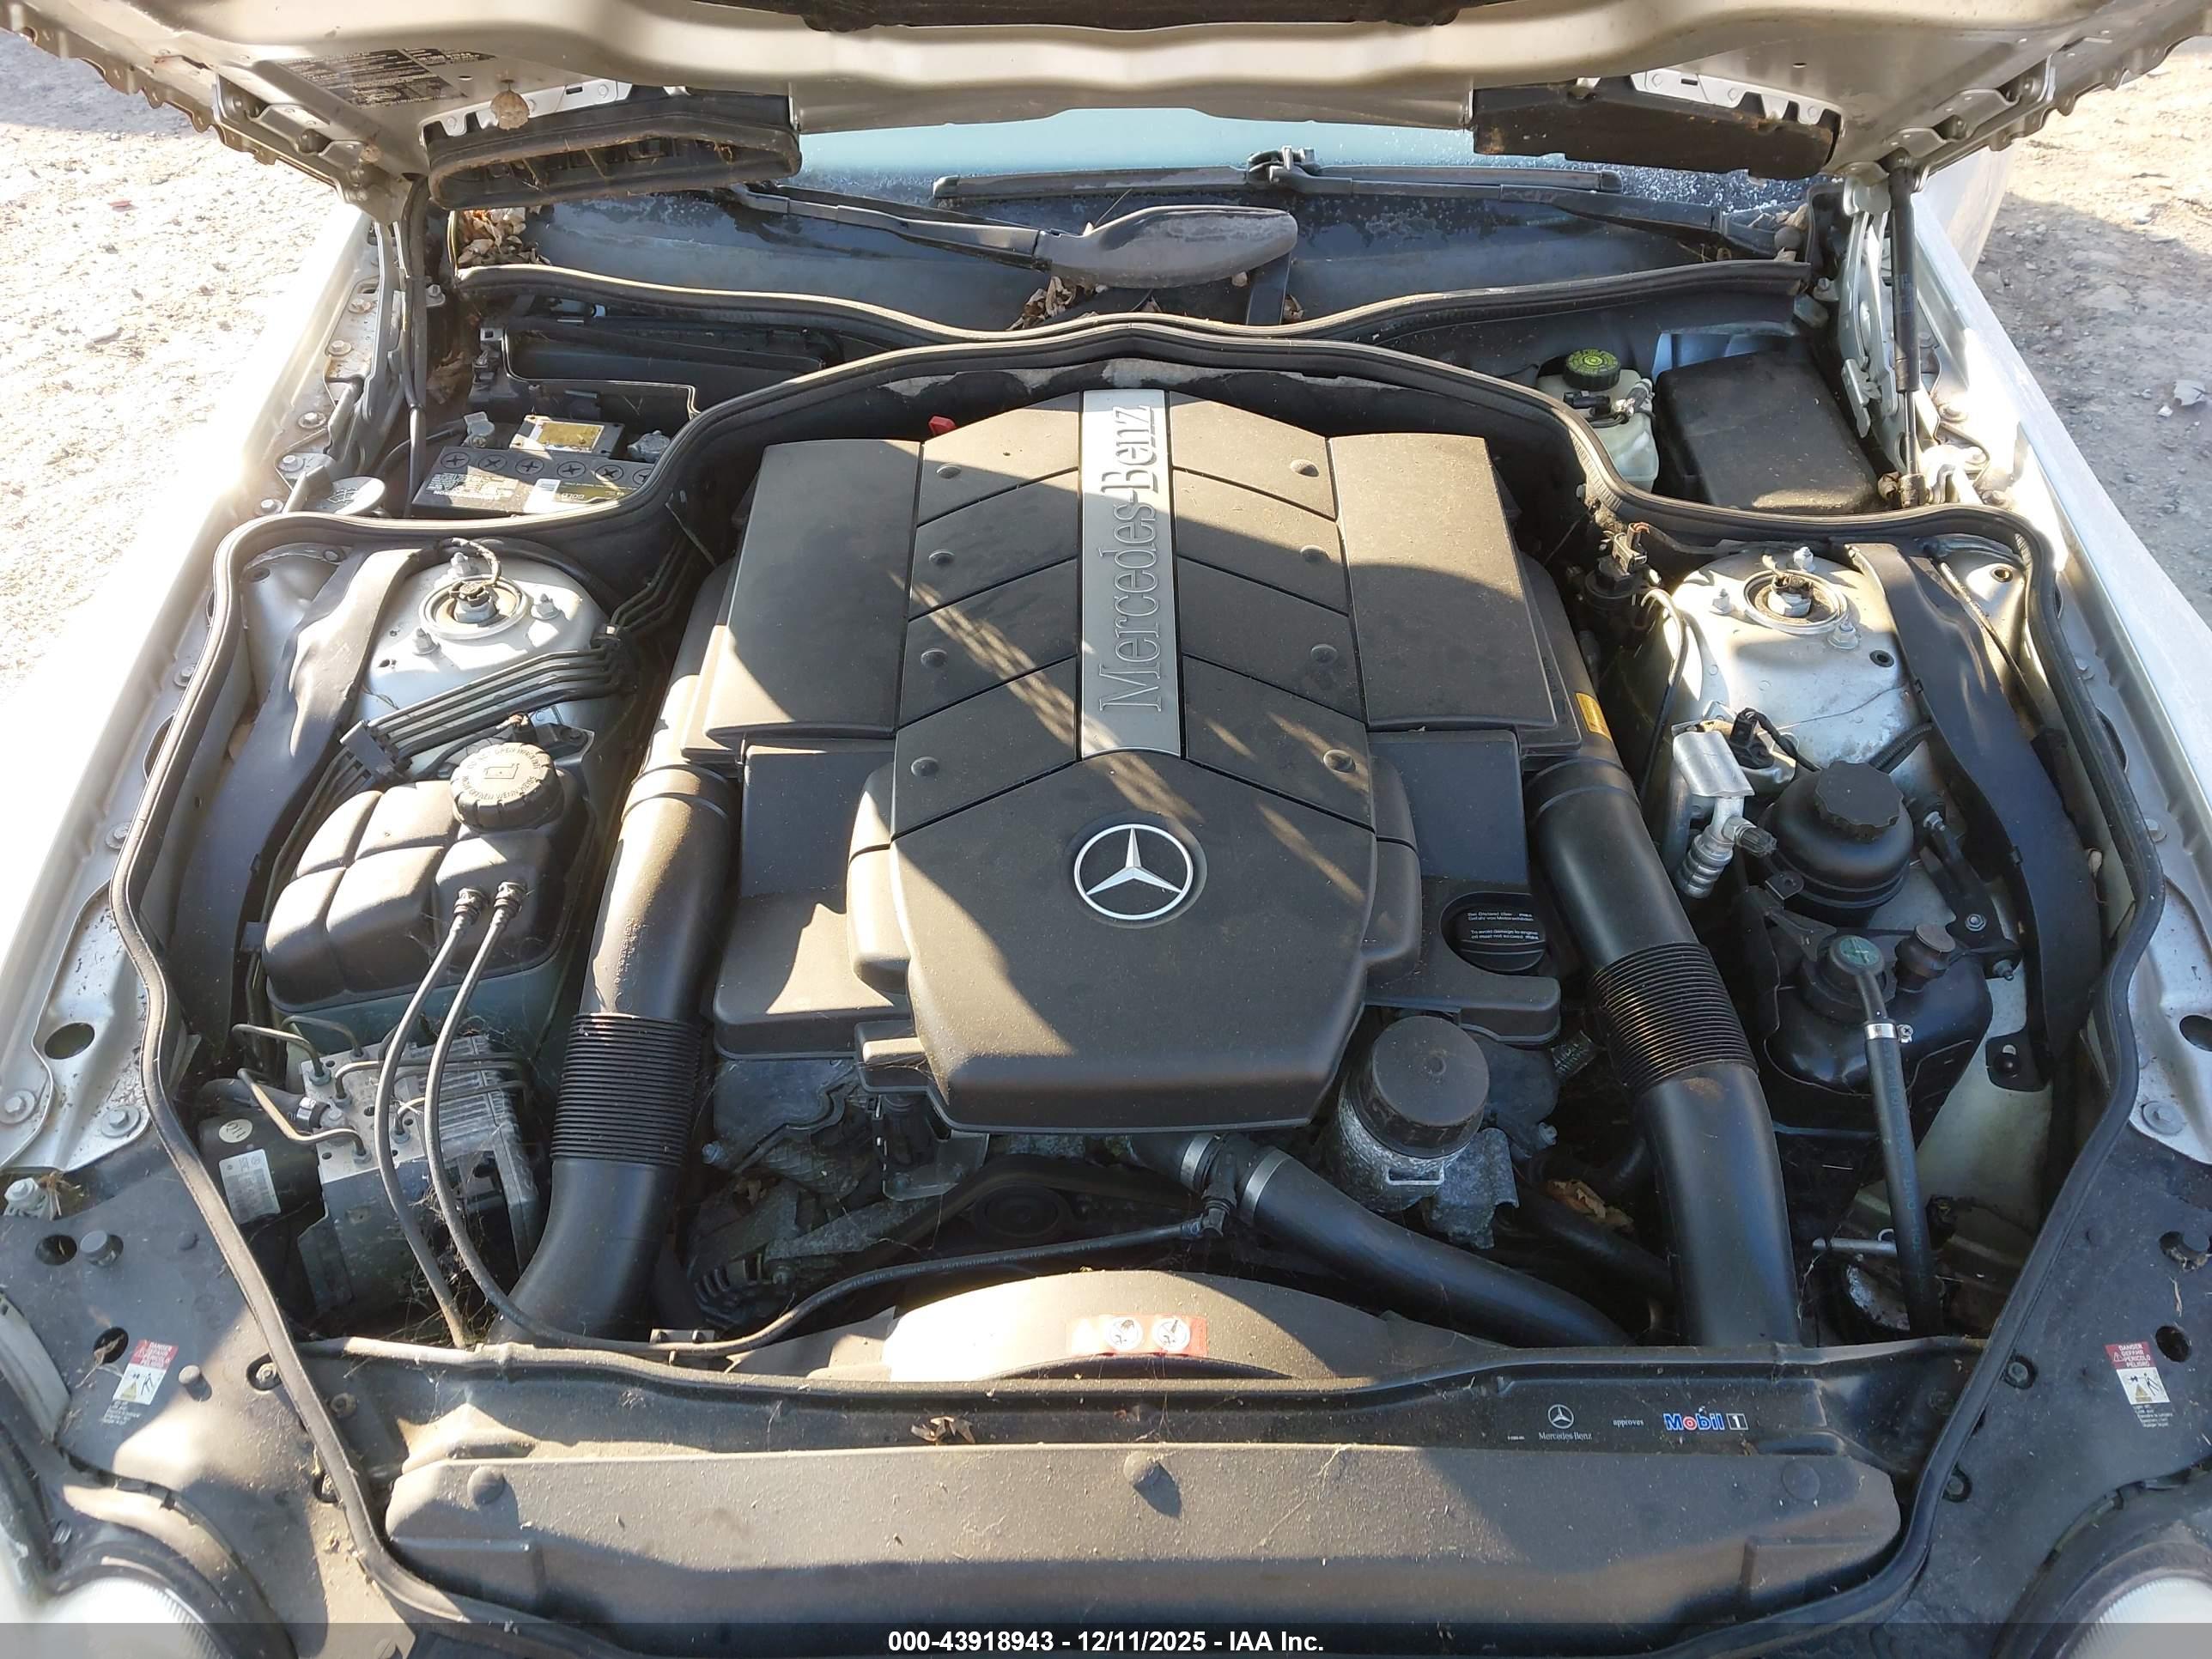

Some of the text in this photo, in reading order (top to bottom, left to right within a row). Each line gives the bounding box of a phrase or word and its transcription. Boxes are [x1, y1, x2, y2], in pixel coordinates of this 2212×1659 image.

[1098, 404, 1162, 713] Mercedes-Benz
[1613, 1418, 1644, 1426] approves
[1662, 1413, 1725, 1431] Mobil
[1538, 1431, 1593, 1441] Mercedes-Benz
